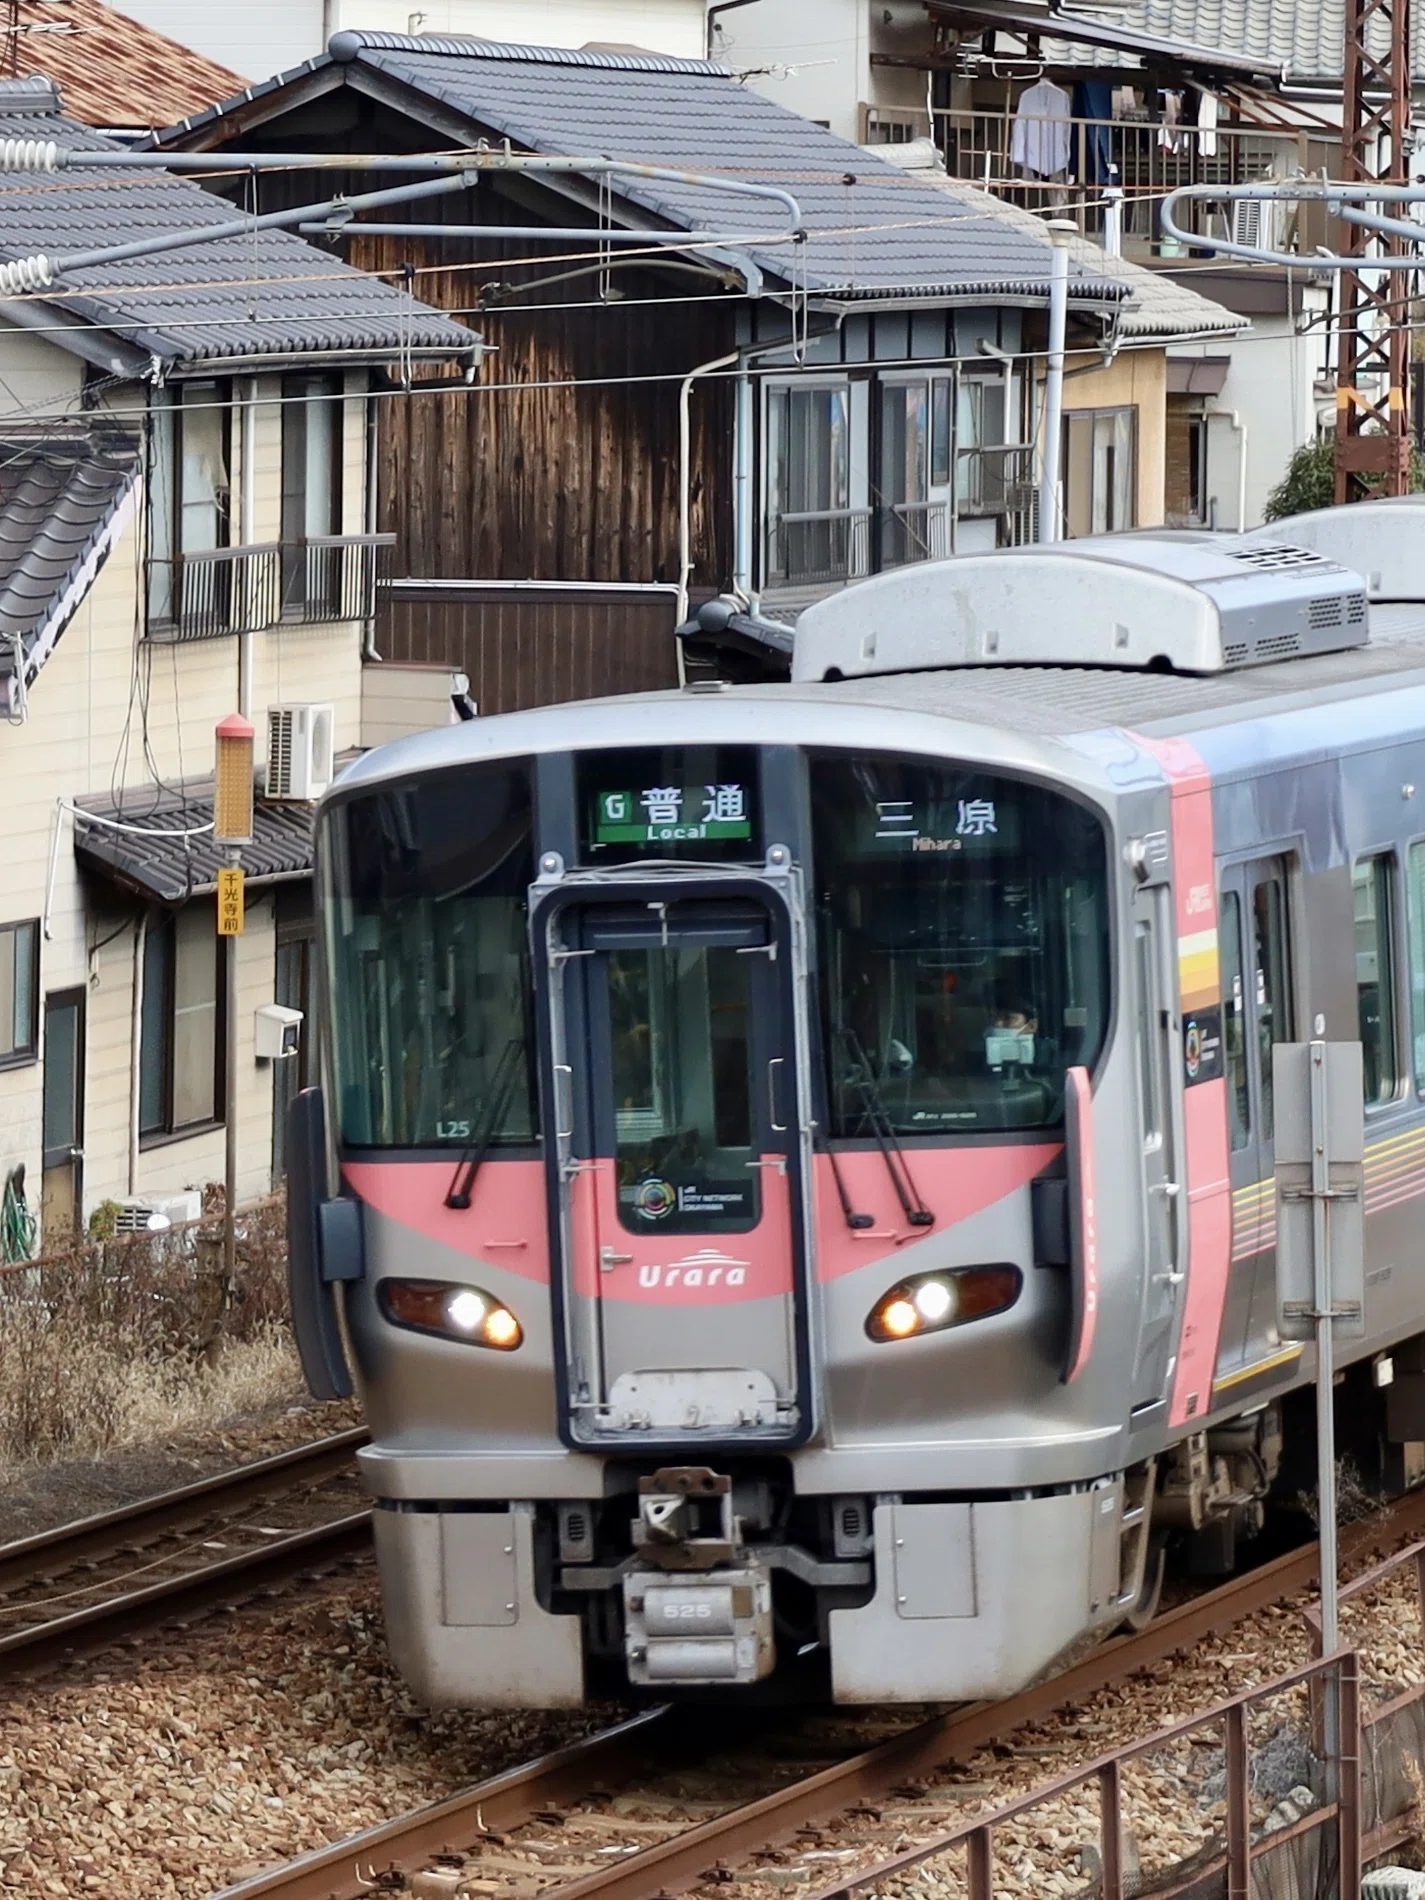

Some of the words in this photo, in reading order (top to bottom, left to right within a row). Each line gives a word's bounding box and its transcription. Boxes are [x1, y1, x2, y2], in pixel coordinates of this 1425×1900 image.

[605, 794, 625, 819] G
[640, 784, 747, 824] 普通
[875, 799, 998, 836] 三原
[647, 824, 707, 841] Local
[912, 837, 962, 852] Mihara
[223, 872, 239, 932] 千光寺前
[436, 1121, 470, 1138] L25
[639, 1264, 747, 1289] Urara
[663, 1604, 712, 1618] 525
